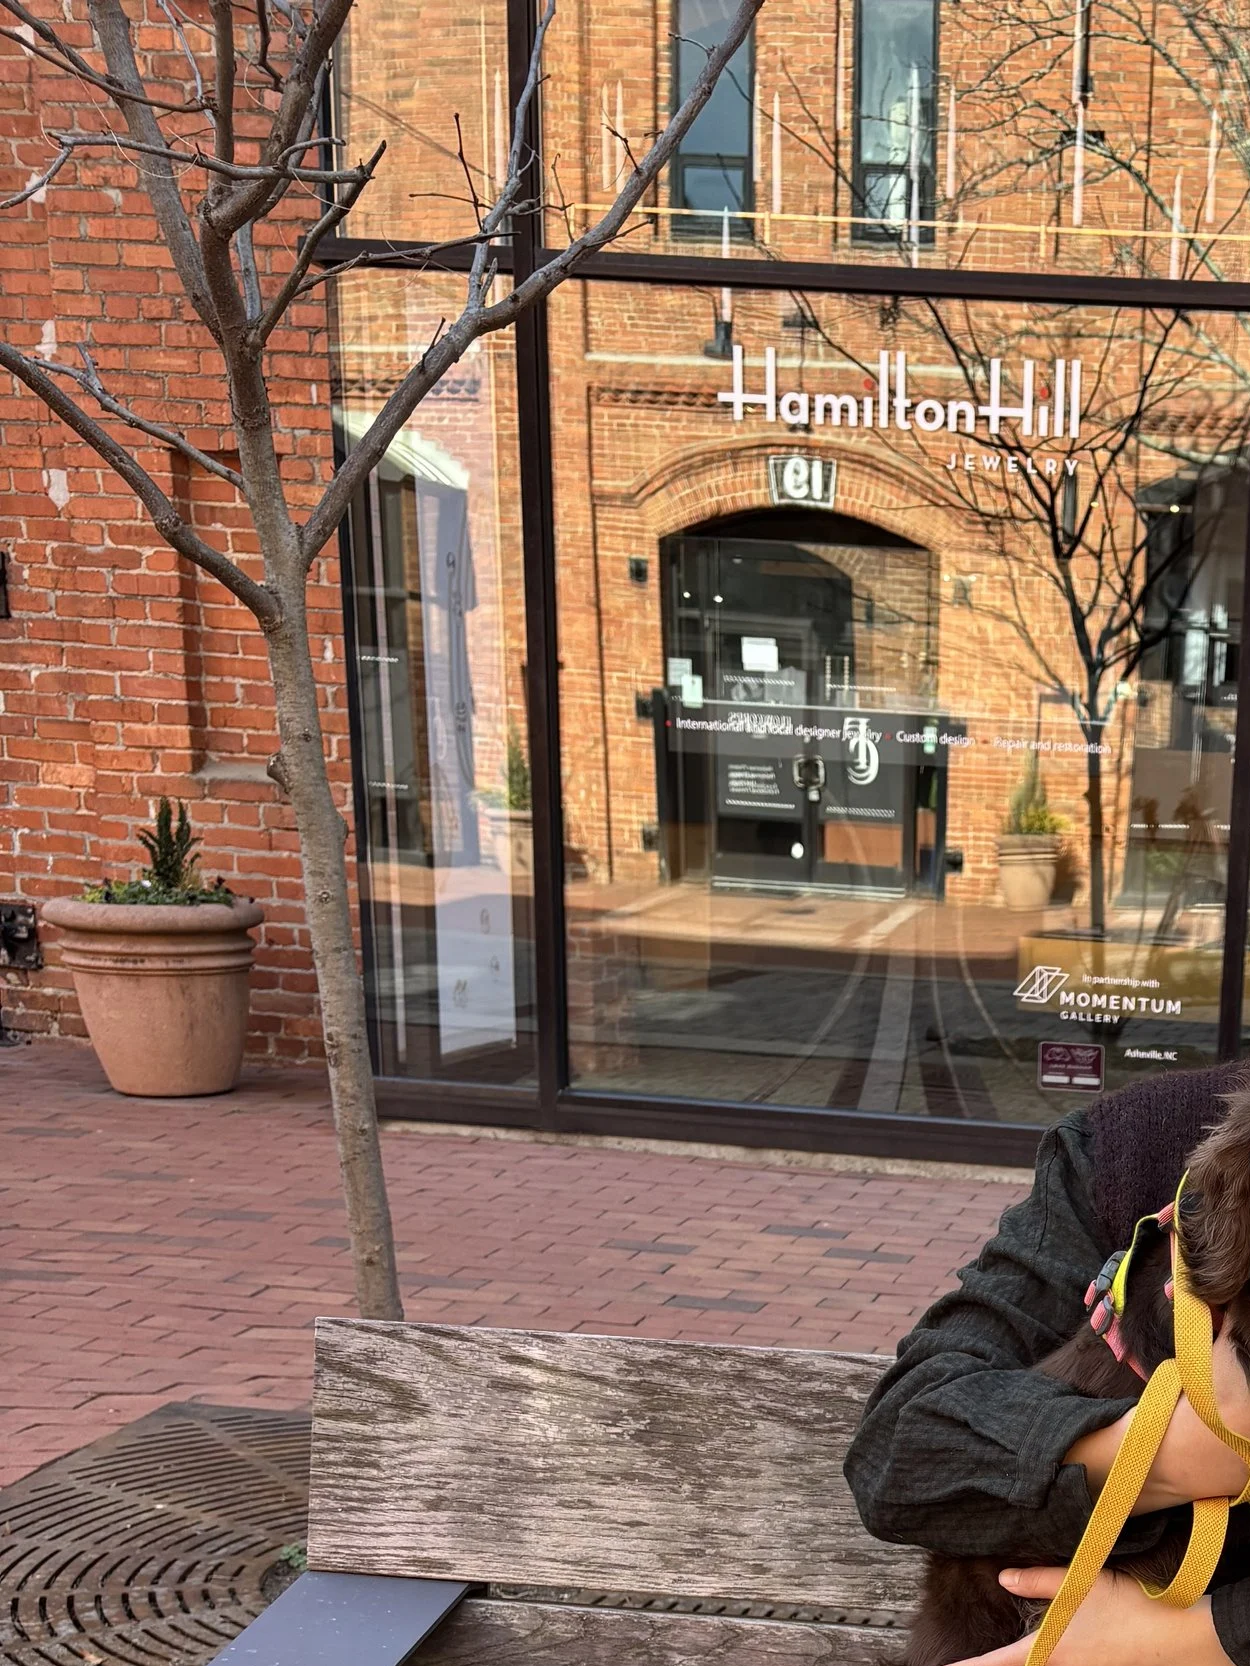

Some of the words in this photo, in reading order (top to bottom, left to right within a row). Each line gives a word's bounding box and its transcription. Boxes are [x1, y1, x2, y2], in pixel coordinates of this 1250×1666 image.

[946, 453, 1079, 477] JEWELRY
[676, 717, 744, 732] International
[767, 720, 793, 735] local
[794, 723, 841, 740] designer
[896, 730, 937, 744] Custom
[939, 733, 975, 748] design
[993, 736, 1028, 752] Repair
[1030, 739, 1052, 750] and
[1053, 741, 1112, 754] restoration
[1082, 974, 1092, 984] In
[1092, 975, 1140, 988] partnership
[1140, 979, 1160, 988] with
[1059, 991, 1182, 1014] MOMENTUM
[1060, 1010, 1120, 1024] GALLERY
[1164, 1051, 1178, 1061] NC
